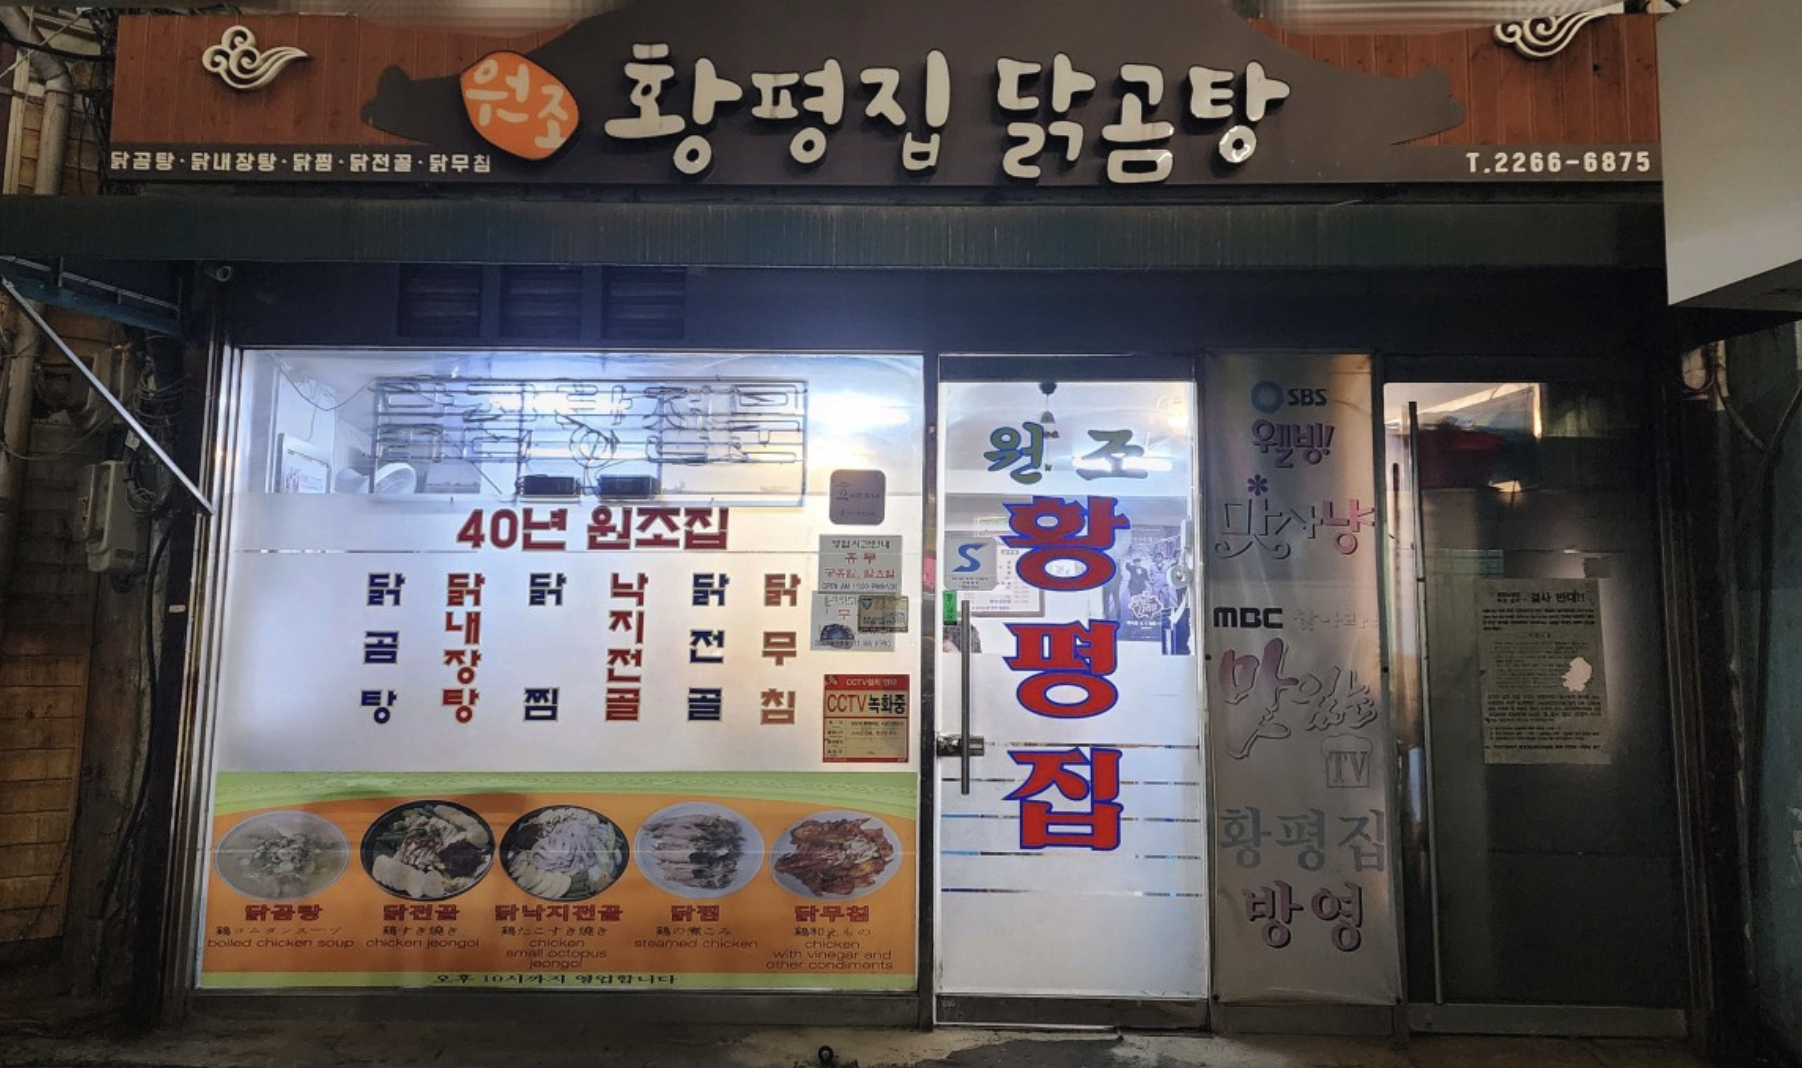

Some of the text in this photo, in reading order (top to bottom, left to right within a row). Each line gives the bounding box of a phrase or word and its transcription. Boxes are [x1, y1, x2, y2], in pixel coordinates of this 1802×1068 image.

[464, 58, 568, 149] 원조
[603, 43, 1291, 184] 황평집 닭곰탕
[110, 151, 491, 173] 닭곰탕 닭내장탕 닭찜 닭전골 닭무침
[1466, 151, 1650, 174] T.2266-6875
[1288, 388, 1327, 406] SBS
[983, 421, 1149, 485] 원조
[456, 506, 729, 552] 40년 원조집
[1213, 606, 1284, 629] MBC
[360, 572, 406, 725] 닭곰탕
[441, 572, 486, 724] 닭내장탕
[605, 572, 649, 722] 낙지전골
[687, 572, 730, 722] 닭전골
[759, 572, 802, 725] 닭무침
[999, 495, 1131, 850] 황평집
[827, 694, 906, 715] CCTV 녹화중
[1327, 751, 1368, 784] TV
[1220, 806, 1386, 873] 황평집
[244, 904, 323, 921] 닭곰탕
[383, 904, 460, 921] 닭전골
[495, 904, 623, 922] 닭낙지전골
[672, 905, 720, 922] 닭찜
[795, 905, 870, 922] 닭무침
[1243, 880, 1363, 953] 방영
[208, 938, 355, 949] boiled chicken soup
[366, 938, 479, 949] chicken jeongol
[529, 938, 585, 948] chicken
[634, 939, 758, 949] steamed chicken
[805, 940, 860, 949] chicken
[506, 949, 608, 960] small octopus
[529, 959, 583, 970] jeongol
[765, 960, 893, 970] other condiments
[772, 950, 892, 961] with vinegar and
[434, 974, 475, 984] 오후
